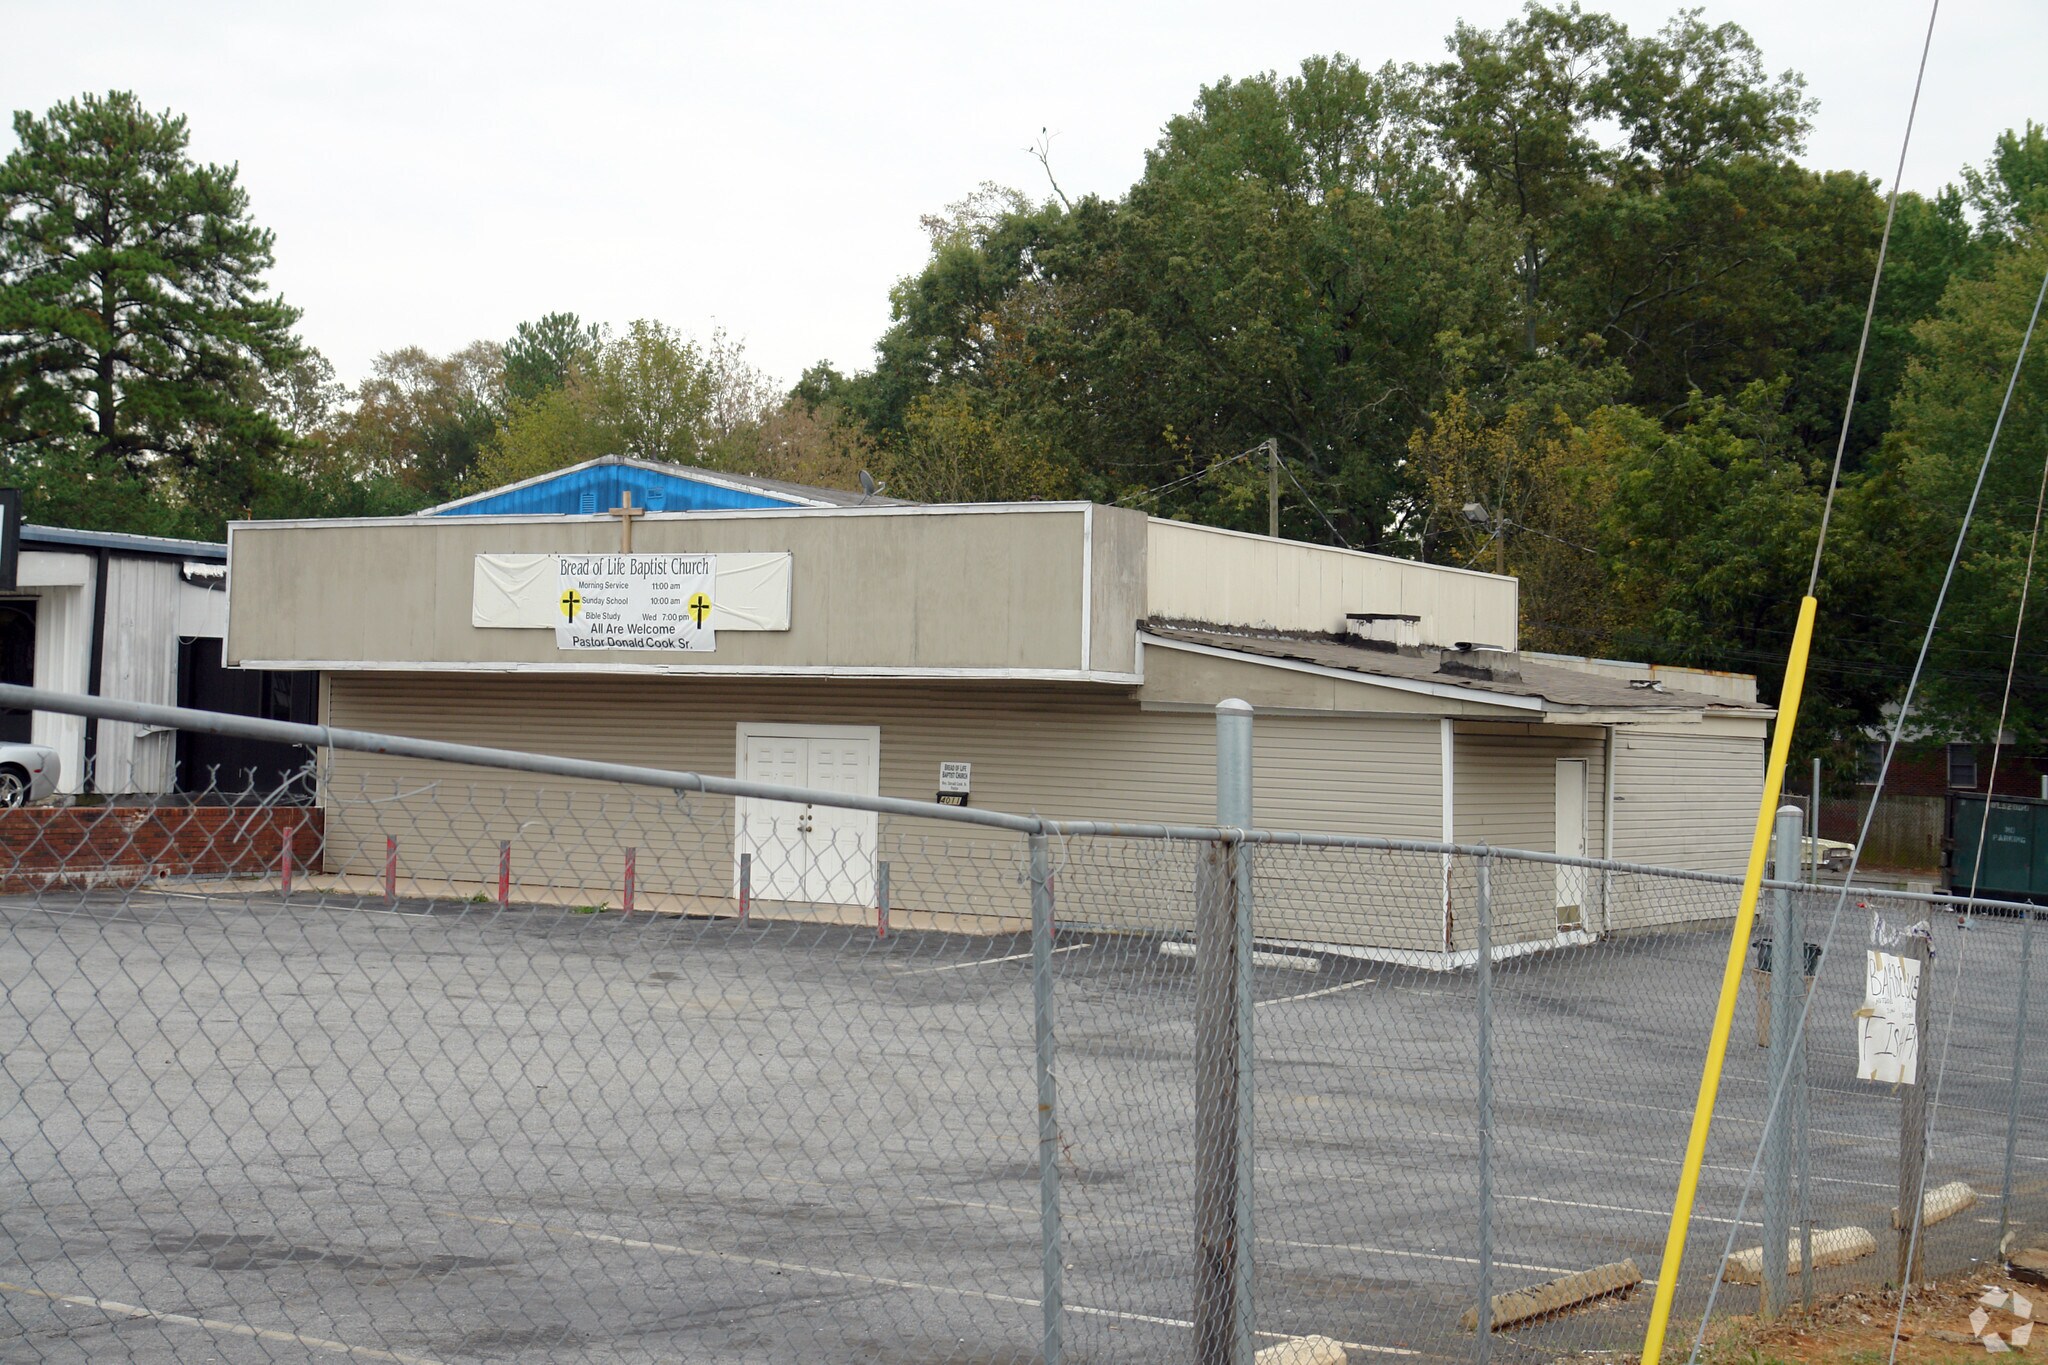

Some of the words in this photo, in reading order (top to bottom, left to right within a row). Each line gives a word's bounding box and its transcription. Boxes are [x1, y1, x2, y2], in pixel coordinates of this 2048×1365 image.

[560, 558, 589, 575] Bread
[592, 558, 604, 575] of
[607, 558, 625, 575] Life
[630, 558, 667, 579] Baptist
[671, 558, 709, 575] Church
[579, 582, 604, 590] Morning
[582, 597, 604, 605] Sunday
[602, 612, 621, 621] Study
[642, 613, 657, 621] Wed
[591, 623, 603, 634] All
[606, 624, 623, 634] Are
[627, 624, 675, 634] Welcome
[572, 636, 604, 647] Pastor
[607, 637, 644, 648] Donald
[646, 638, 674, 648] Cook
[678, 638, 692, 649] Sr.
[1992, 834, 2026, 843] PARKING
